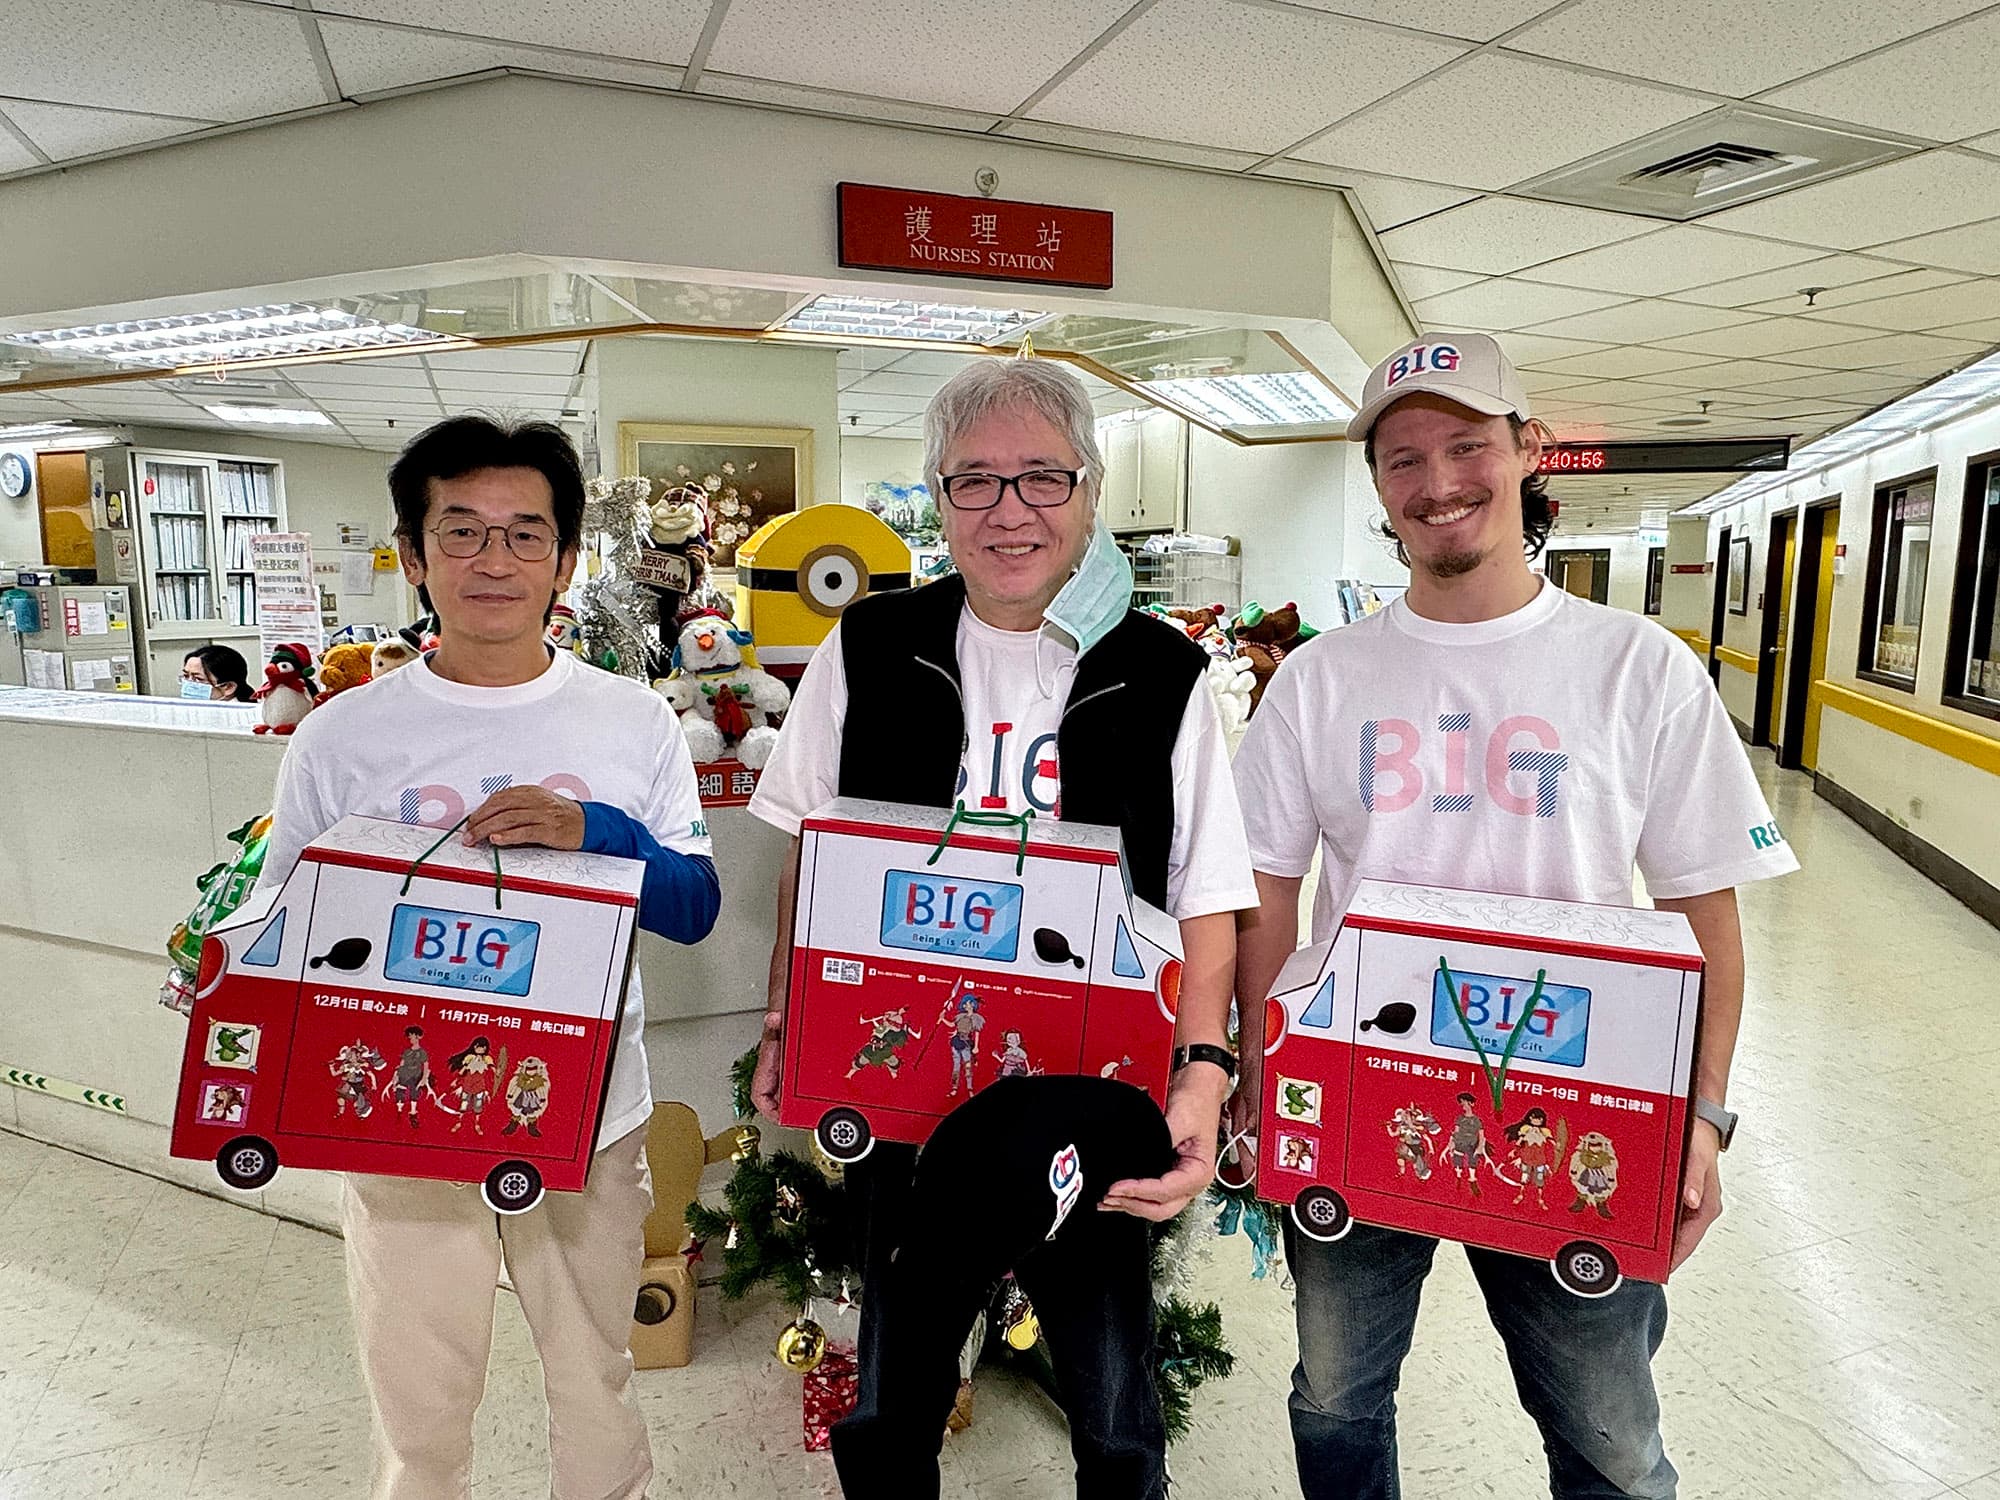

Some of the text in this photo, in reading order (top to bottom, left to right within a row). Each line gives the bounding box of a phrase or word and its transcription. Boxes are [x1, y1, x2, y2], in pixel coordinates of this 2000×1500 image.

[904, 205, 1062, 253] 護理站
[909, 244, 1055, 272] NURSES STATION
[1387, 346, 1460, 387] BIG
[641, 554, 669, 569] MERRY
[699, 771, 756, 796] 細語
[955, 722, 1061, 817] IG
[1358, 712, 1569, 818] BIG
[906, 882, 996, 935] BIG
[413, 917, 511, 970] BIG
[912, 934, 981, 950] Being is Gift
[420, 967, 492, 984] Being is Gift
[313, 994, 359, 1010] 12月1日
[1460, 982, 1561, 1038] BIG
[1521, 1042, 1544, 1053] Gift
[1366, 1056, 1409, 1074] 12月1日
[1500, 1079, 1579, 1102] 月17日-19日
